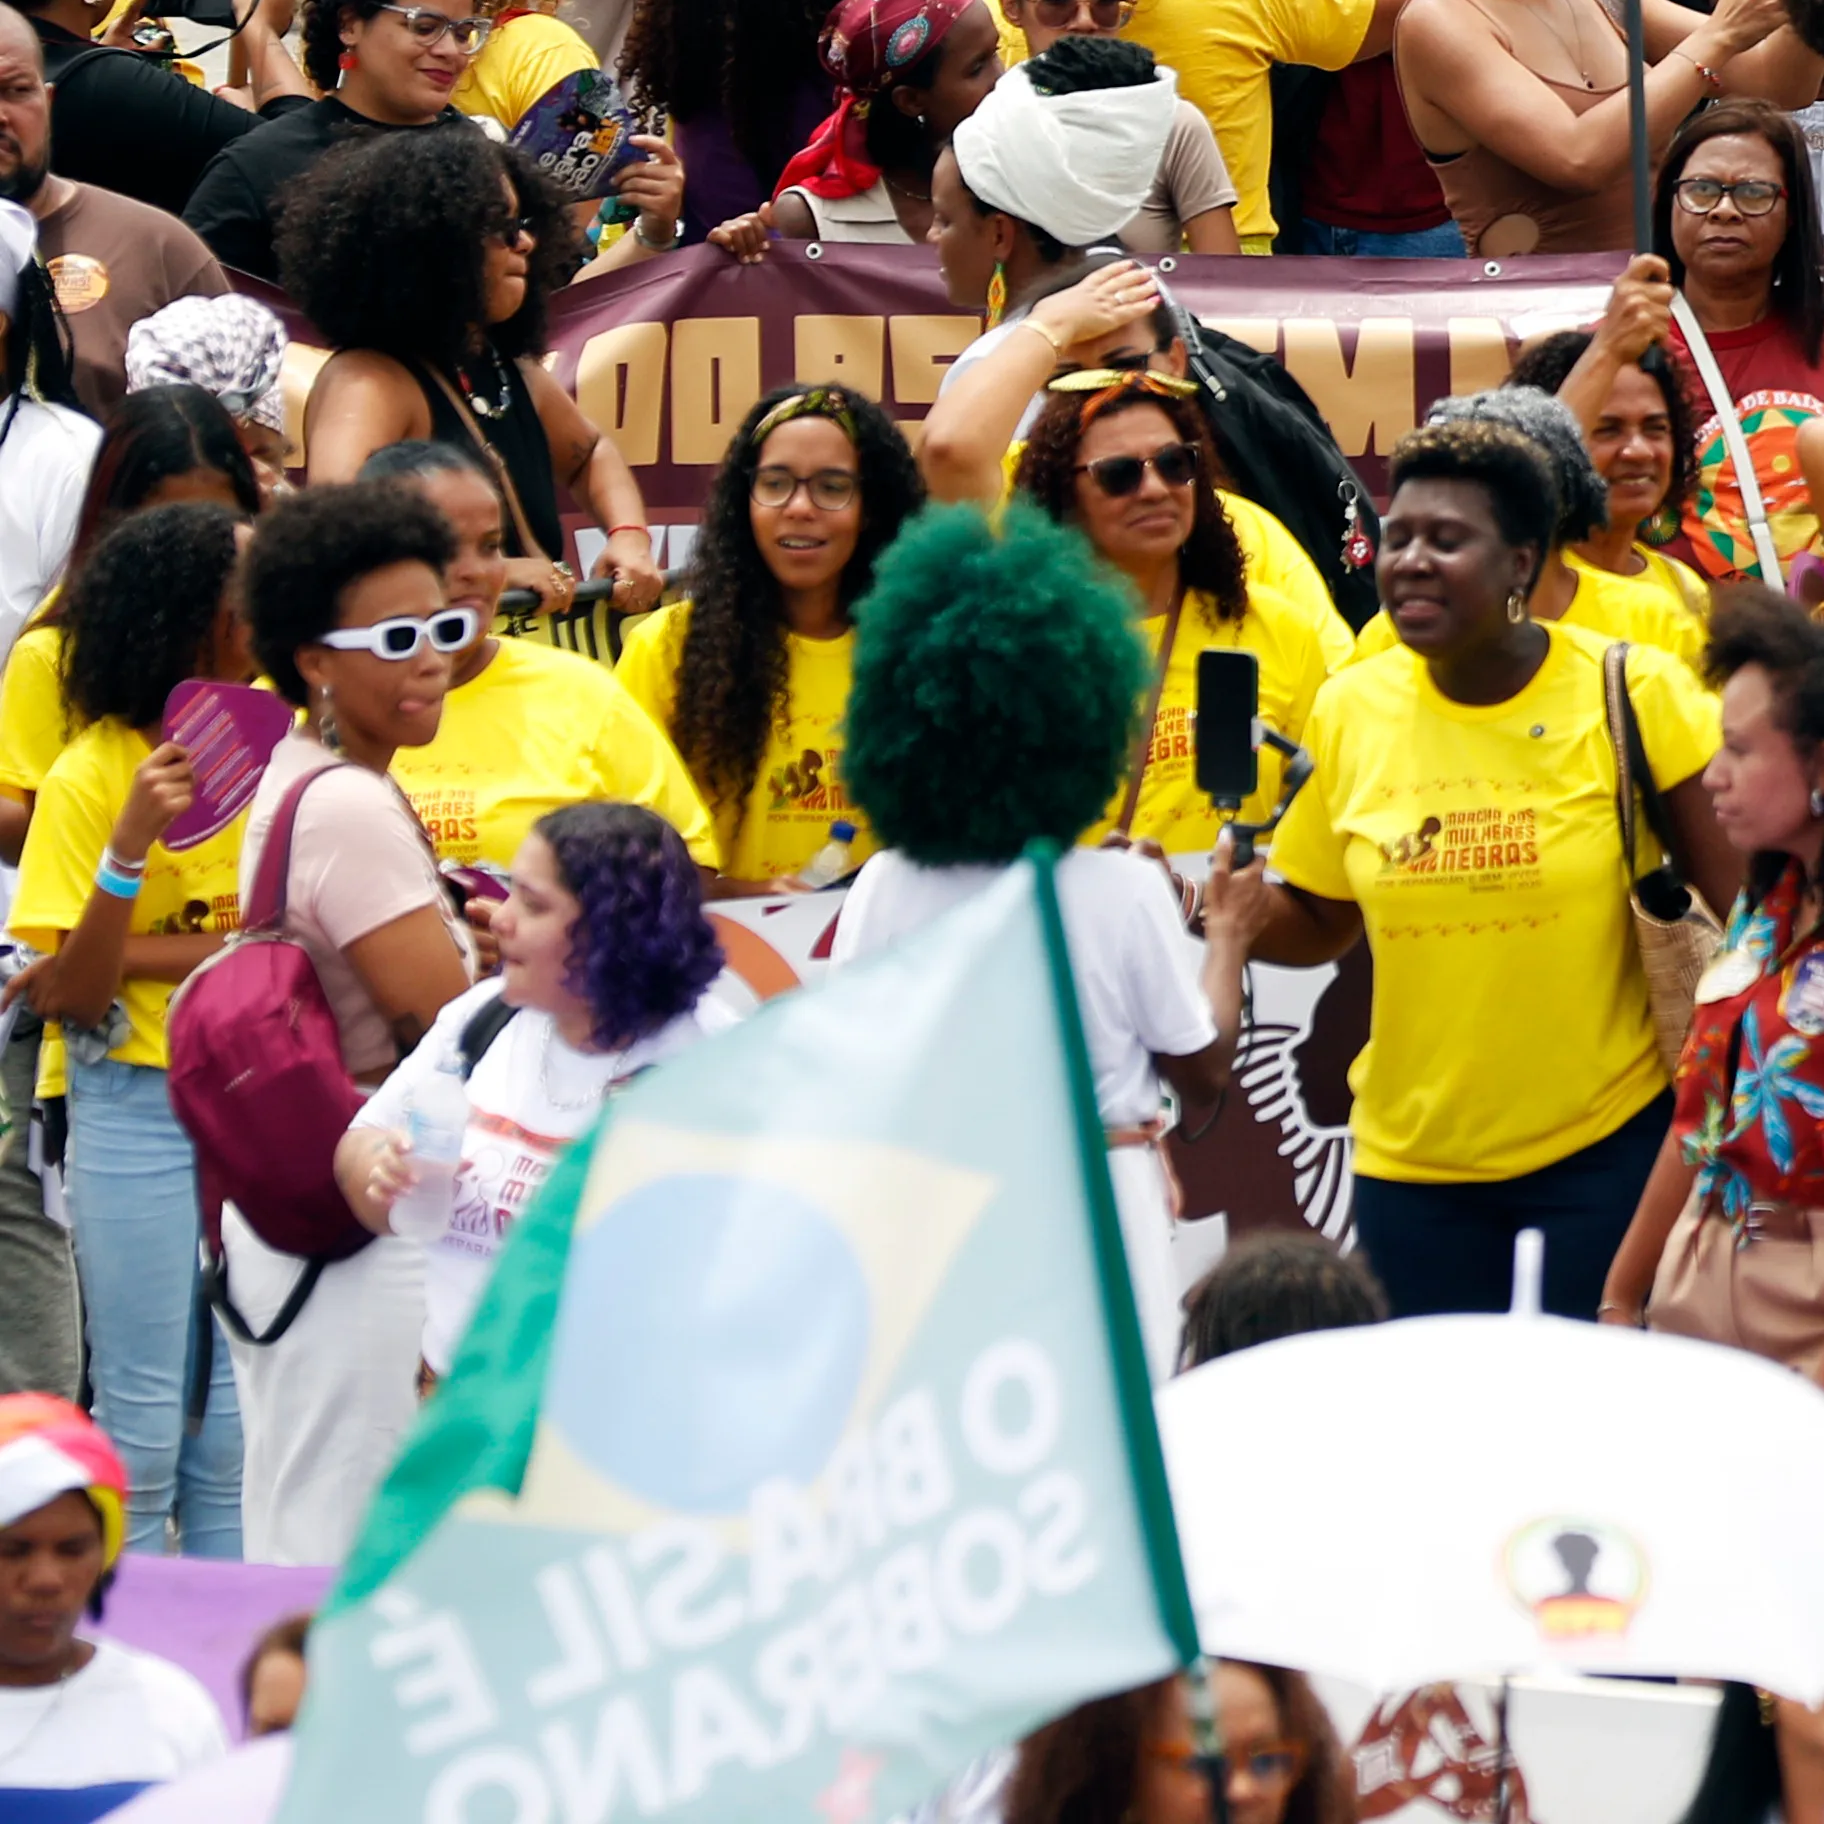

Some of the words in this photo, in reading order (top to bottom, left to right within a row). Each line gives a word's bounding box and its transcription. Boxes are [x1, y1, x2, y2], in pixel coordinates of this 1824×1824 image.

[1740, 391, 1770, 412] DE
[1445, 807, 1502, 828] MARCHA
[1444, 824, 1537, 847] MULHERES
[1441, 840, 1539, 873] NEGRAS
